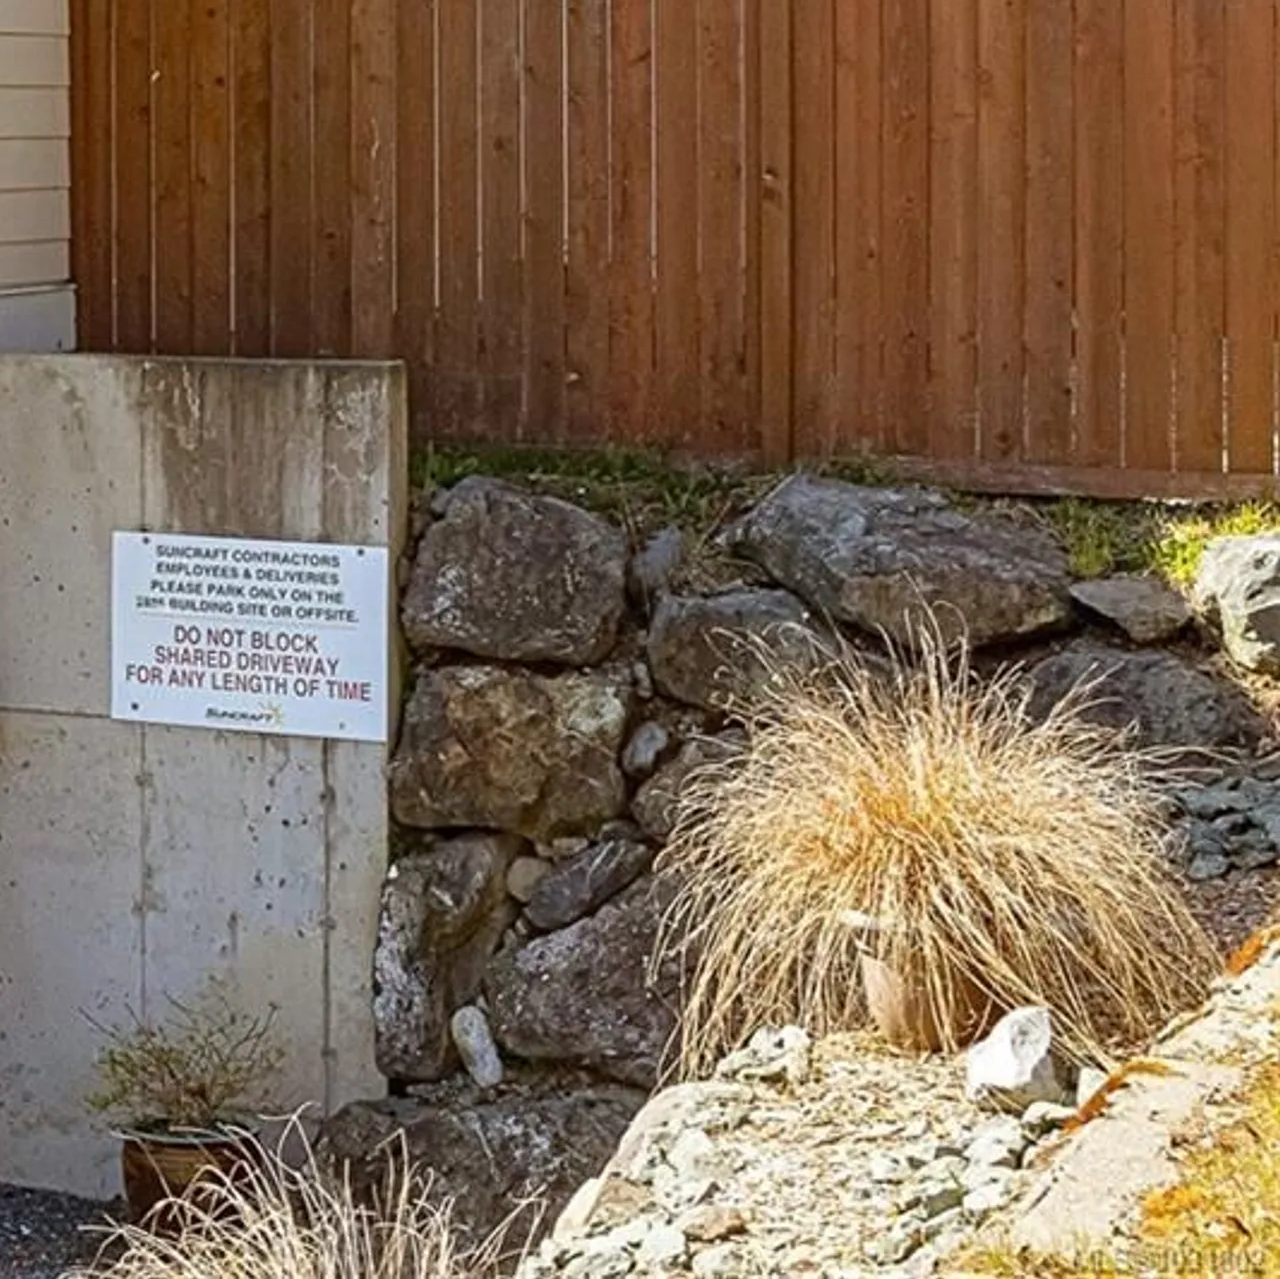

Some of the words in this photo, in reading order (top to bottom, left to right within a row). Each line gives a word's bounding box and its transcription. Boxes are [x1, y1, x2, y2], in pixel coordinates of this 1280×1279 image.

[155, 544, 229, 561] SUNCRAFT
[232, 549, 340, 568] CONTRACTORS
[156, 562, 239, 579] EMPLOYEES
[243, 569, 252, 580] &
[256, 569, 340, 586] DELIVERIES
[150, 580, 203, 595] PLEASE
[207, 583, 244, 599] PARK
[248, 586, 287, 600] ONLY
[290, 588, 312, 602] ON
[317, 590, 344, 604] THE
[169, 598, 234, 614] BUILDING
[238, 601, 267, 616] SITE
[271, 604, 292, 618] OR
[295, 605, 359, 623] OFFSITE.
[173, 624, 201, 645] DO
[207, 628, 246, 648] NOT
[250, 631, 318, 654] BLOCK
[154, 645, 232, 669] SHARED
[237, 652, 339, 677] DRIVEWAY
[126, 664, 163, 684] FOR
[168, 669, 206, 688] ANY
[212, 673, 288, 696] LENGTH
[293, 678, 319, 697] OF
[325, 679, 372, 701] TIME
